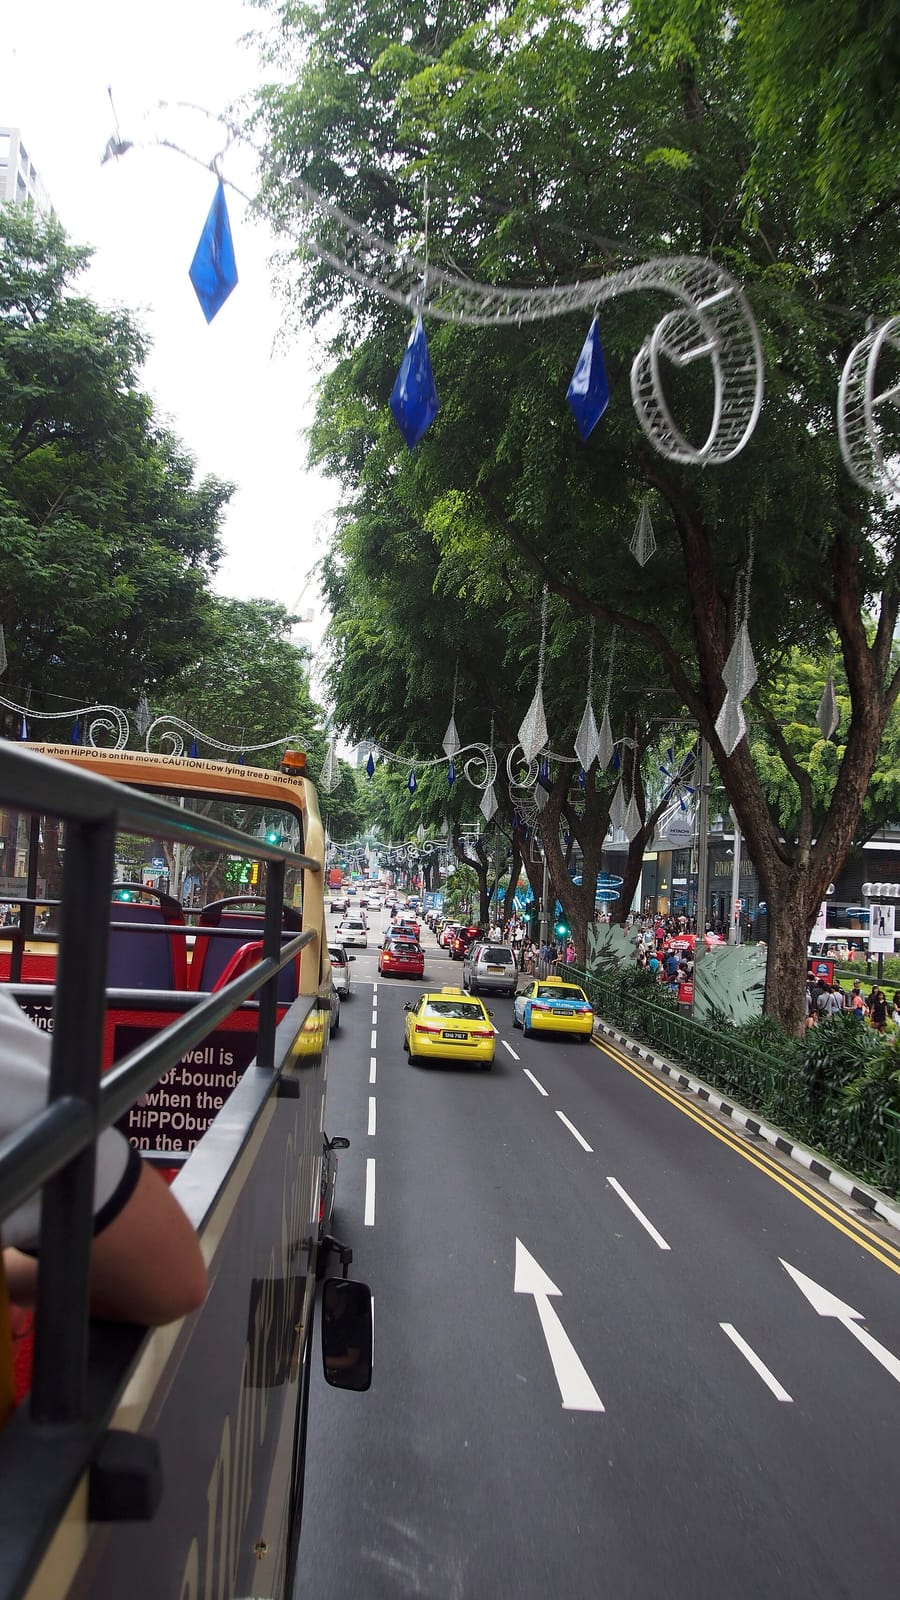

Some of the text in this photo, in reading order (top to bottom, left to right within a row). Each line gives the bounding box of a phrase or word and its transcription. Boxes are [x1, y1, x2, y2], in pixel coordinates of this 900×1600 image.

[71, 747, 98, 757] HiPPO
[119, 753, 134, 761] the
[135, 754, 161, 764] move.
[162, 757, 205, 769] CAUTION!
[225, 766, 246, 777] lying
[246, 770, 263, 778] tree
[180, 1047, 234, 1066] well is
[144, 1089, 224, 1110] when the
[129, 1135, 151, 1151] on
[154, 1134, 184, 1152] the
